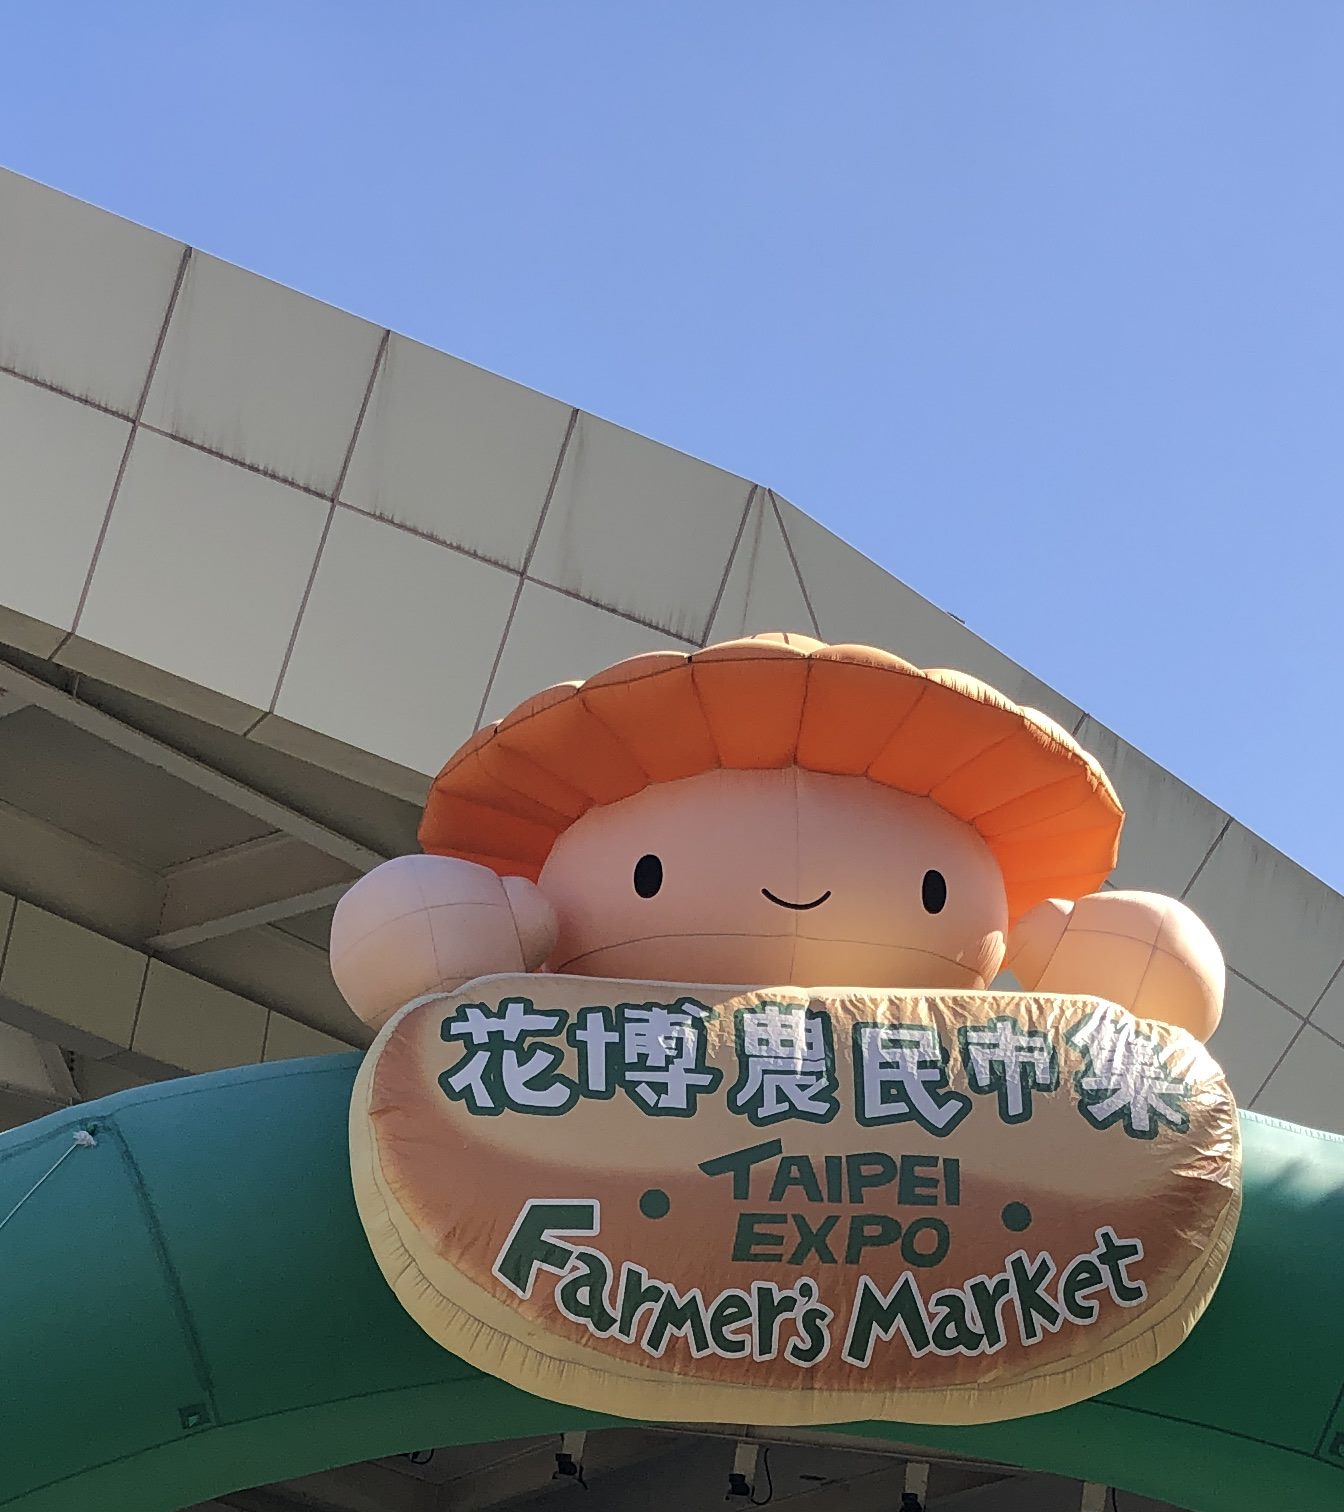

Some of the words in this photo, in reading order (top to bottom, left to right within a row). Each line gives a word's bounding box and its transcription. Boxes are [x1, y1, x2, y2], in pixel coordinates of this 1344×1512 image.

[441, 998, 1192, 1136] 花博農民市集
[698, 1138, 961, 1208] TAIPEI
[494, 1199, 832, 1368] Farmer's
[844, 1227, 1147, 1368] Market
[732, 1213, 951, 1268] EXPO
